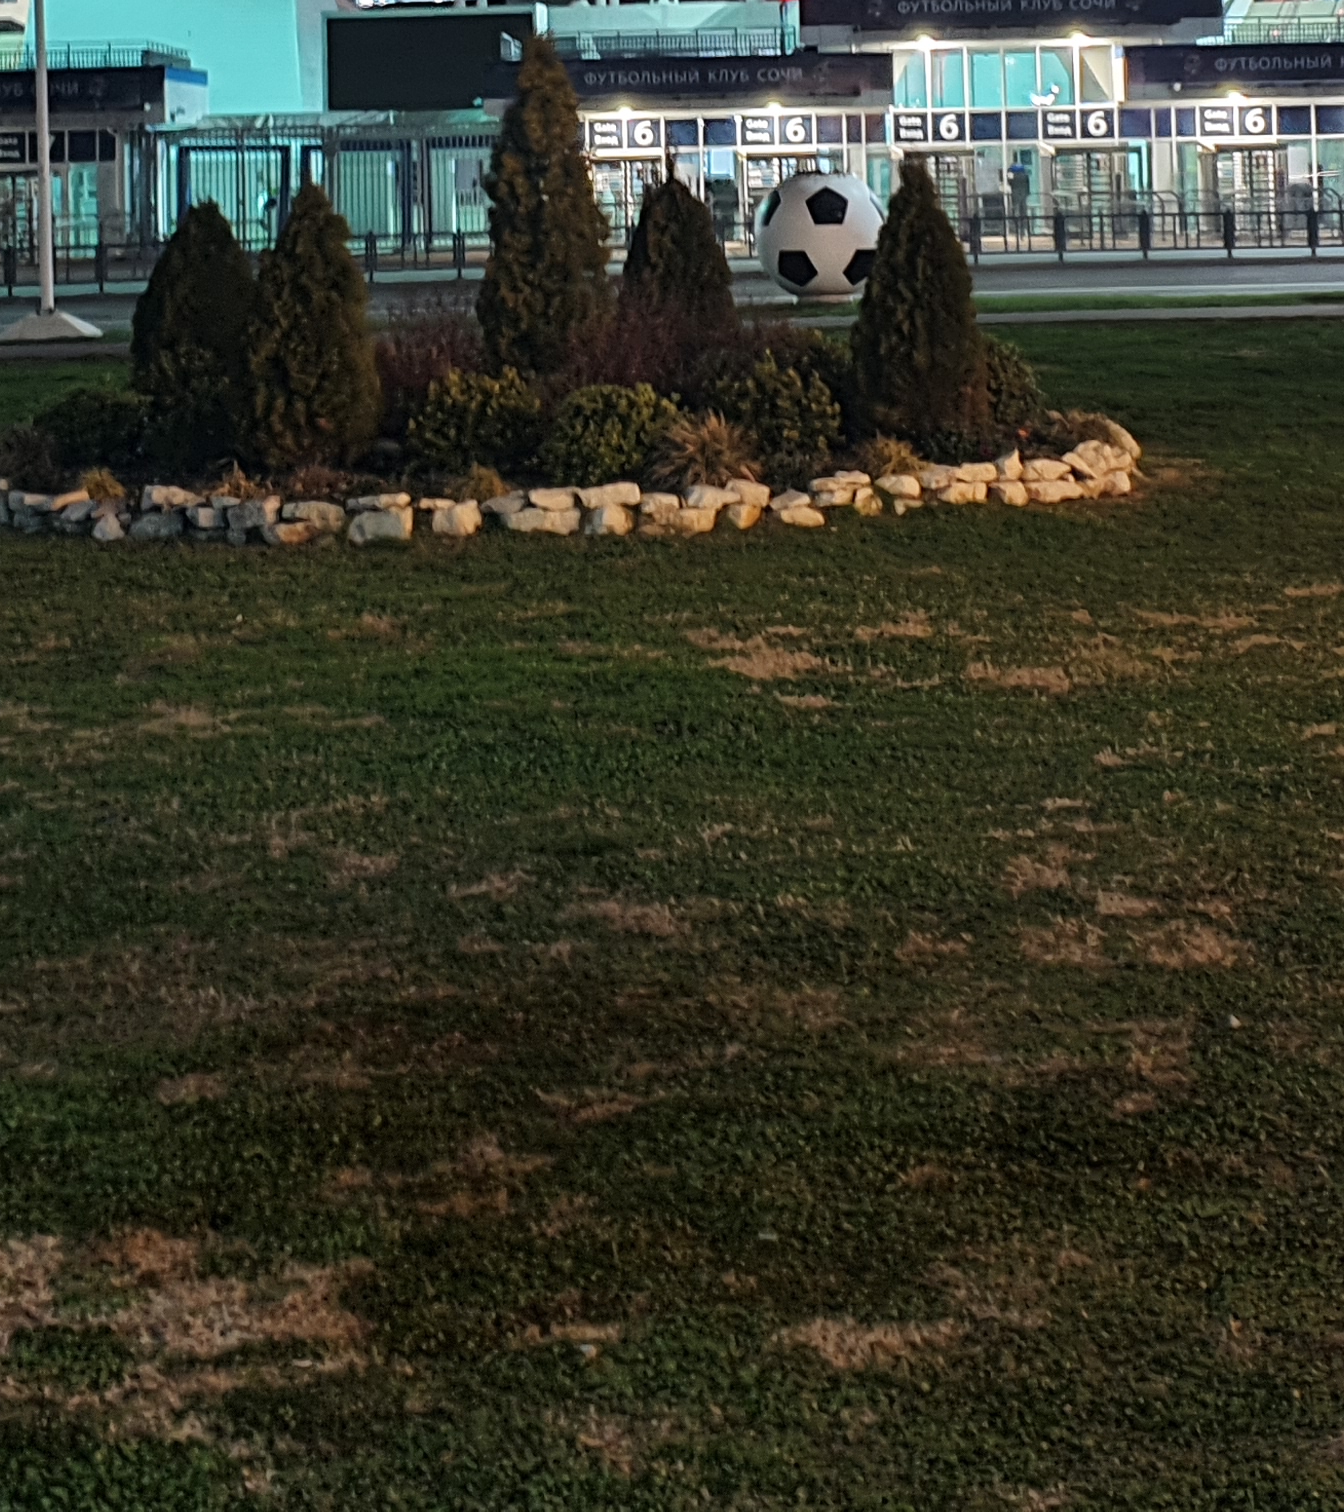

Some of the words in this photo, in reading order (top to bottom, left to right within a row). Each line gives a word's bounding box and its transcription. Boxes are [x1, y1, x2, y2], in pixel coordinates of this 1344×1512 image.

[1214, 55, 1333, 72] ФУТБОЛЬНЫЙ
[583, 68, 701, 86] ФУТБОЛЬНЫЙ
[708, 68, 750, 84] КЛУБ
[757, 67, 803, 83] СОЧИ
[634, 120, 654, 146] 6
[786, 117, 805, 142] 6
[940, 114, 959, 140] 6
[1088, 110, 1107, 137] 6
[1245, 108, 1265, 133] 6
